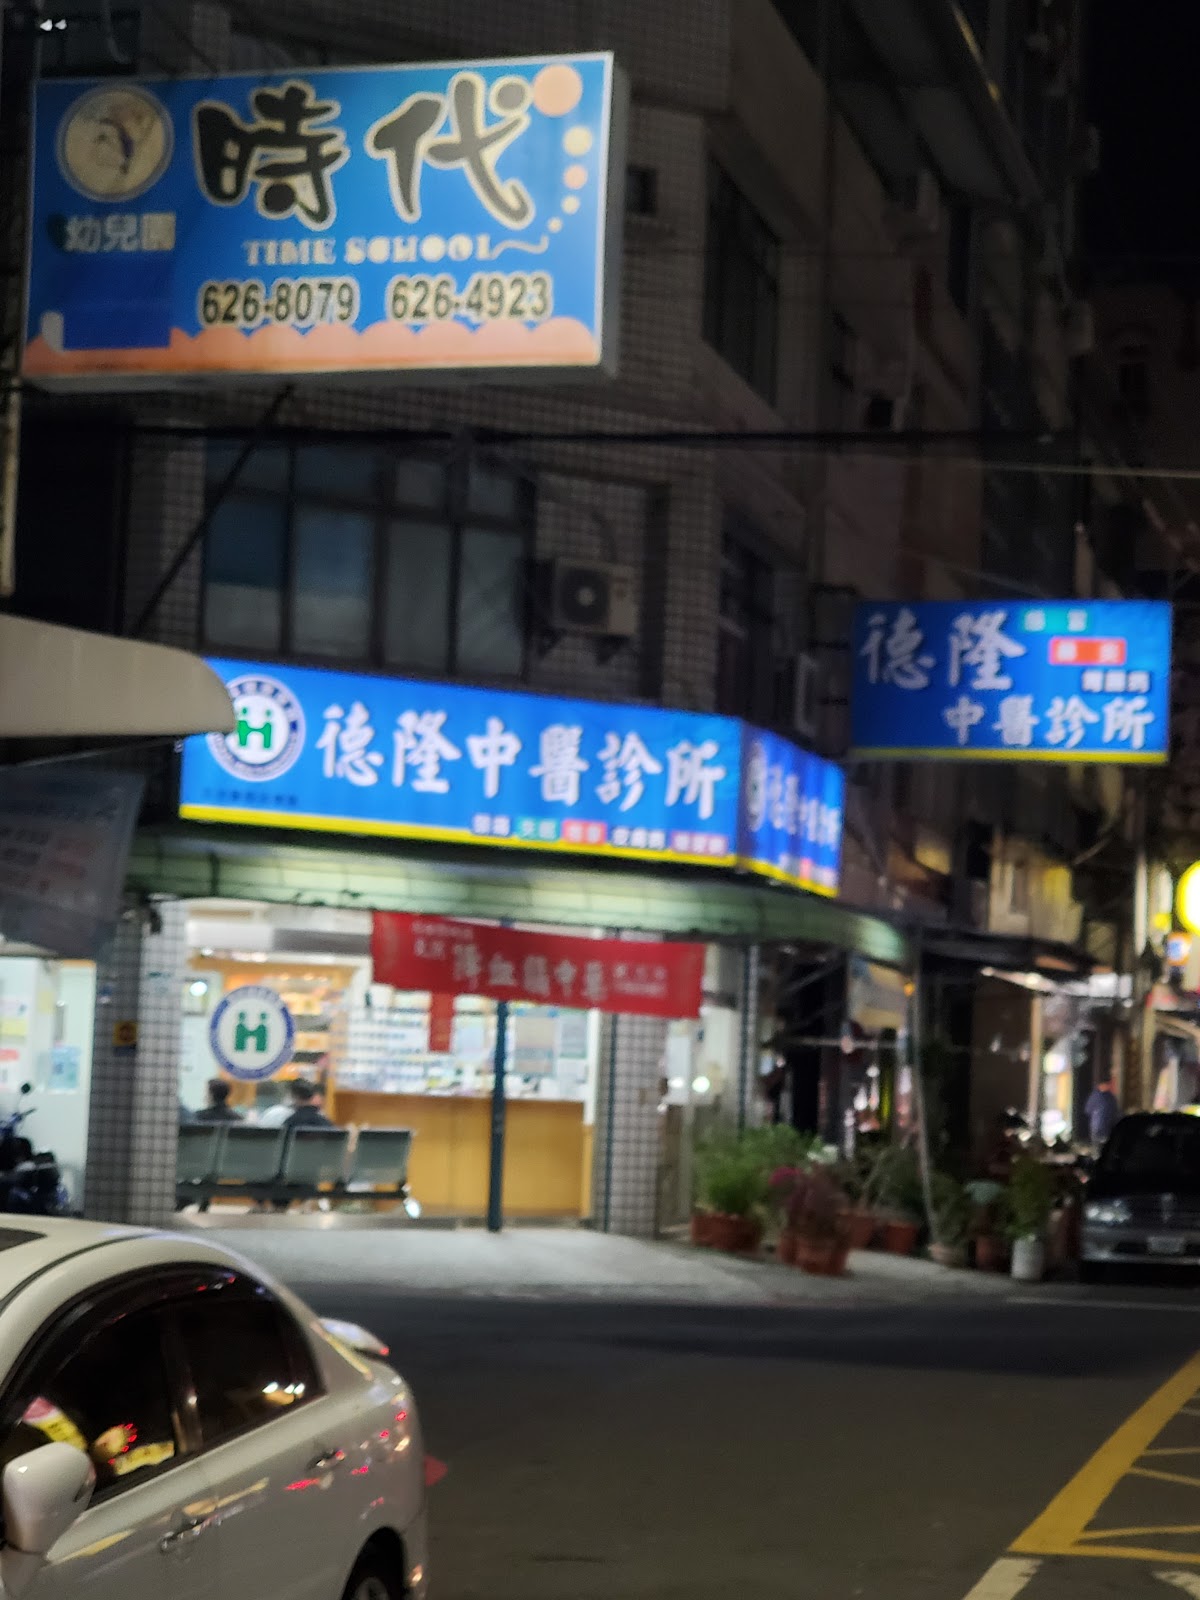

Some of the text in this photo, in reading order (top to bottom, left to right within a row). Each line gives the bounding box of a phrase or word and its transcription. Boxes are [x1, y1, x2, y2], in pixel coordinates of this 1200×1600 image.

[194, 72, 536, 231] 時代
[243, 233, 494, 266] TIME SCHOOL
[316, 700, 727, 820] 德隆中醫診所
[943, 694, 1155, 749] 中醫診所
